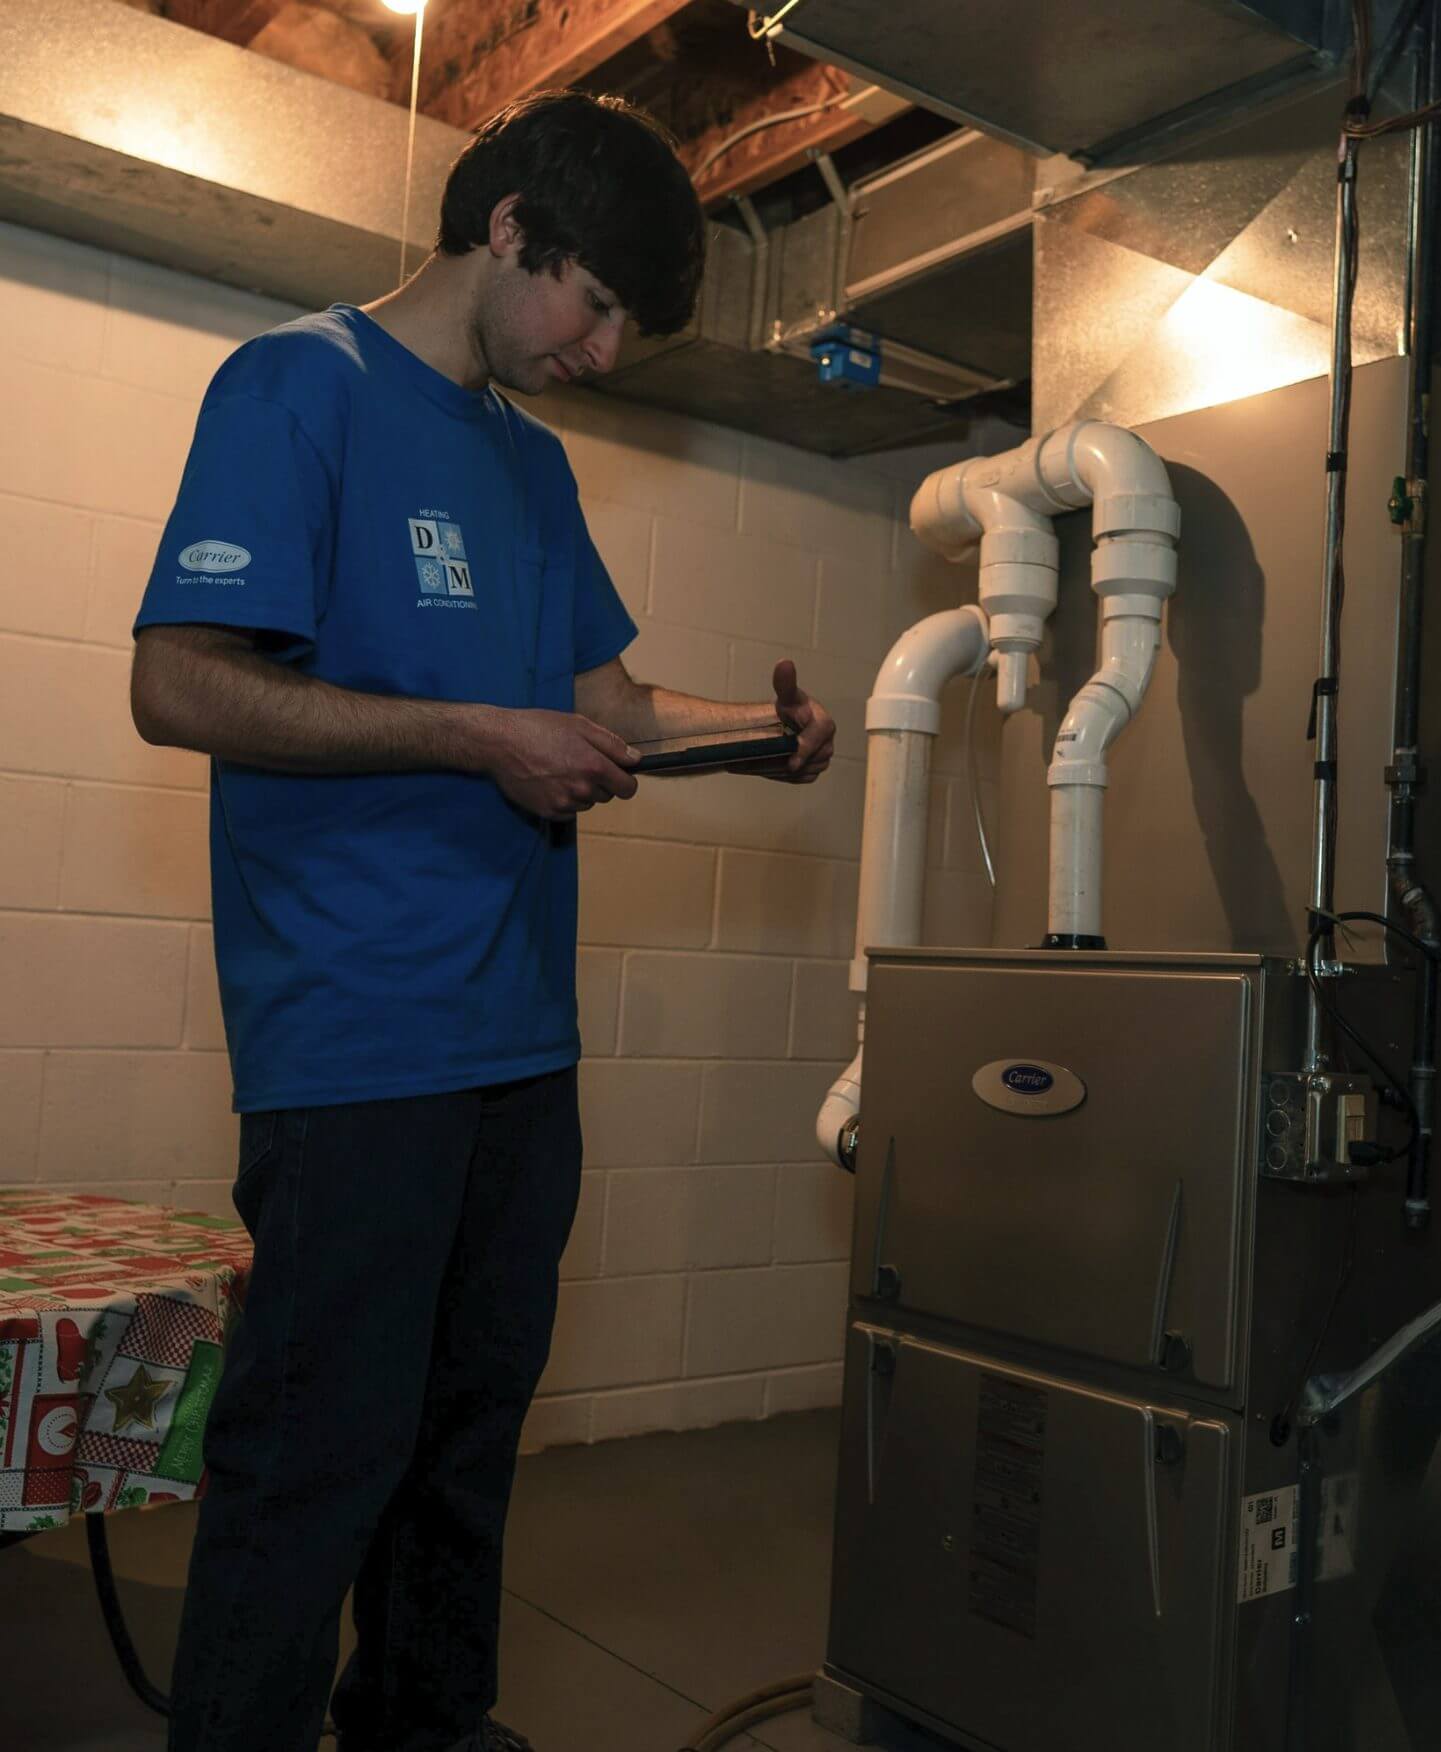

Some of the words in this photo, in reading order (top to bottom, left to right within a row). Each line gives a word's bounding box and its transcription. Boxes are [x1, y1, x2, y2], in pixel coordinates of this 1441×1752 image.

[419, 510, 449, 519] HEATING
[189, 549, 241, 563] Carrier
[415, 526, 433, 549] D
[448, 566, 471, 589] M
[176, 575, 192, 585] Turn
[199, 575, 214, 585] the
[214, 576, 245, 586] experts
[416, 598, 433, 609] AIR
[1008, 1070, 1047, 1086] Carrier
